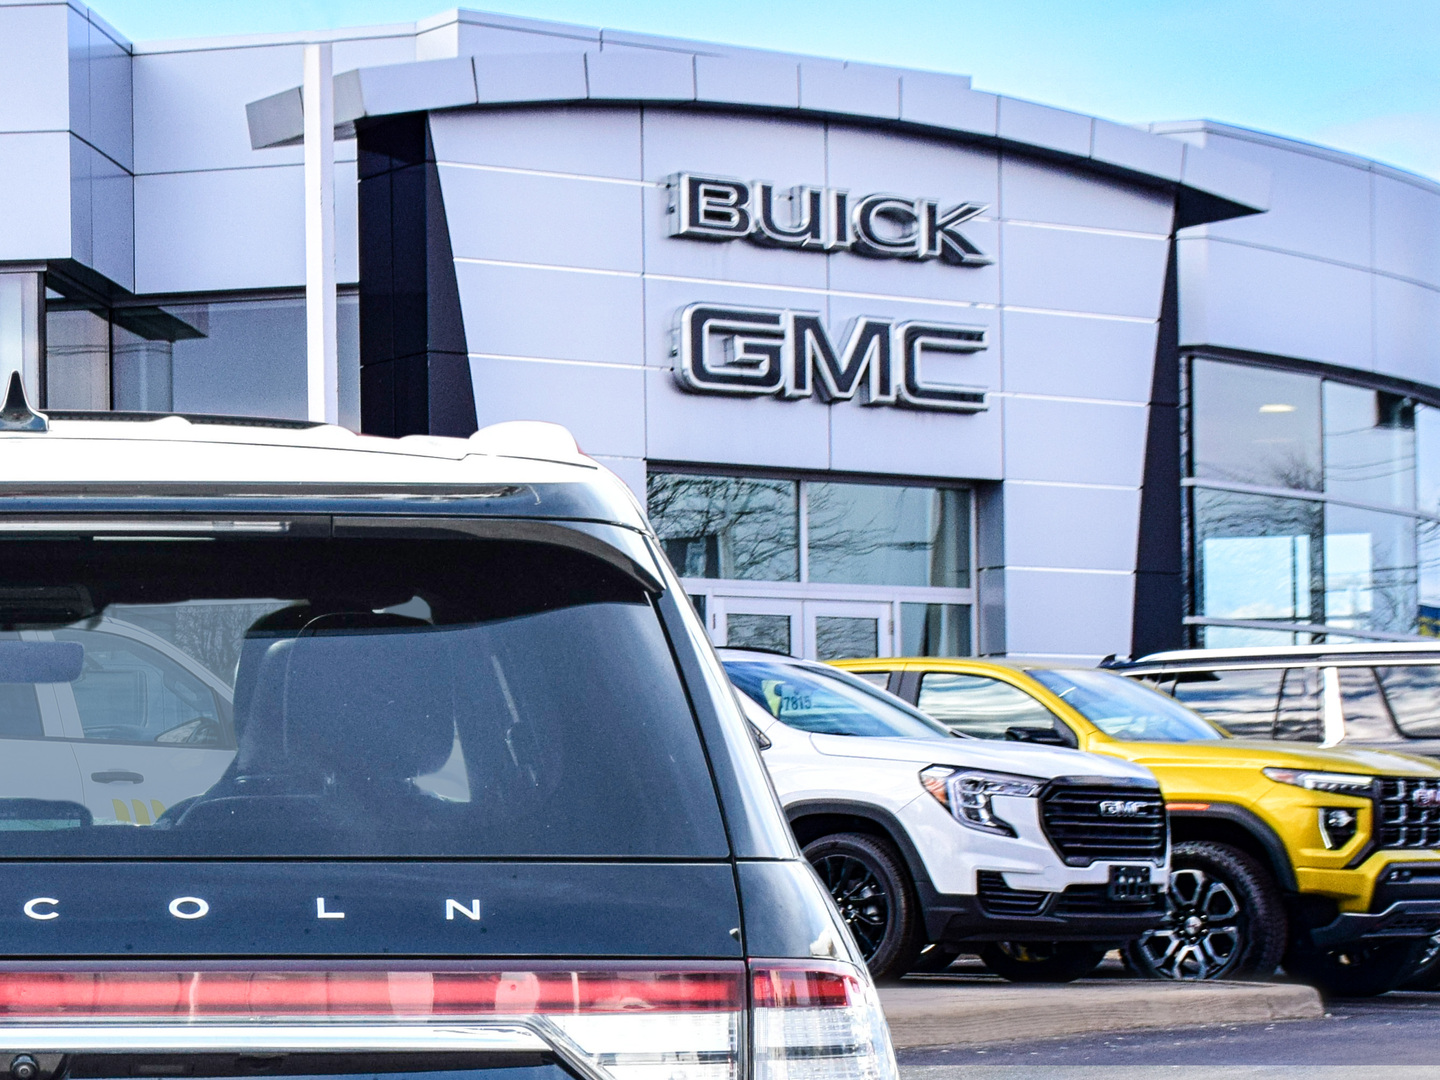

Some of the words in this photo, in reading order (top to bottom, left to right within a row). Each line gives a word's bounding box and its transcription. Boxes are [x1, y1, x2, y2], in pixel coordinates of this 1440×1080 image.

[670, 171, 994, 267] BUICK
[673, 301, 989, 413] GMC
[1100, 800, 1163, 817] GMC
